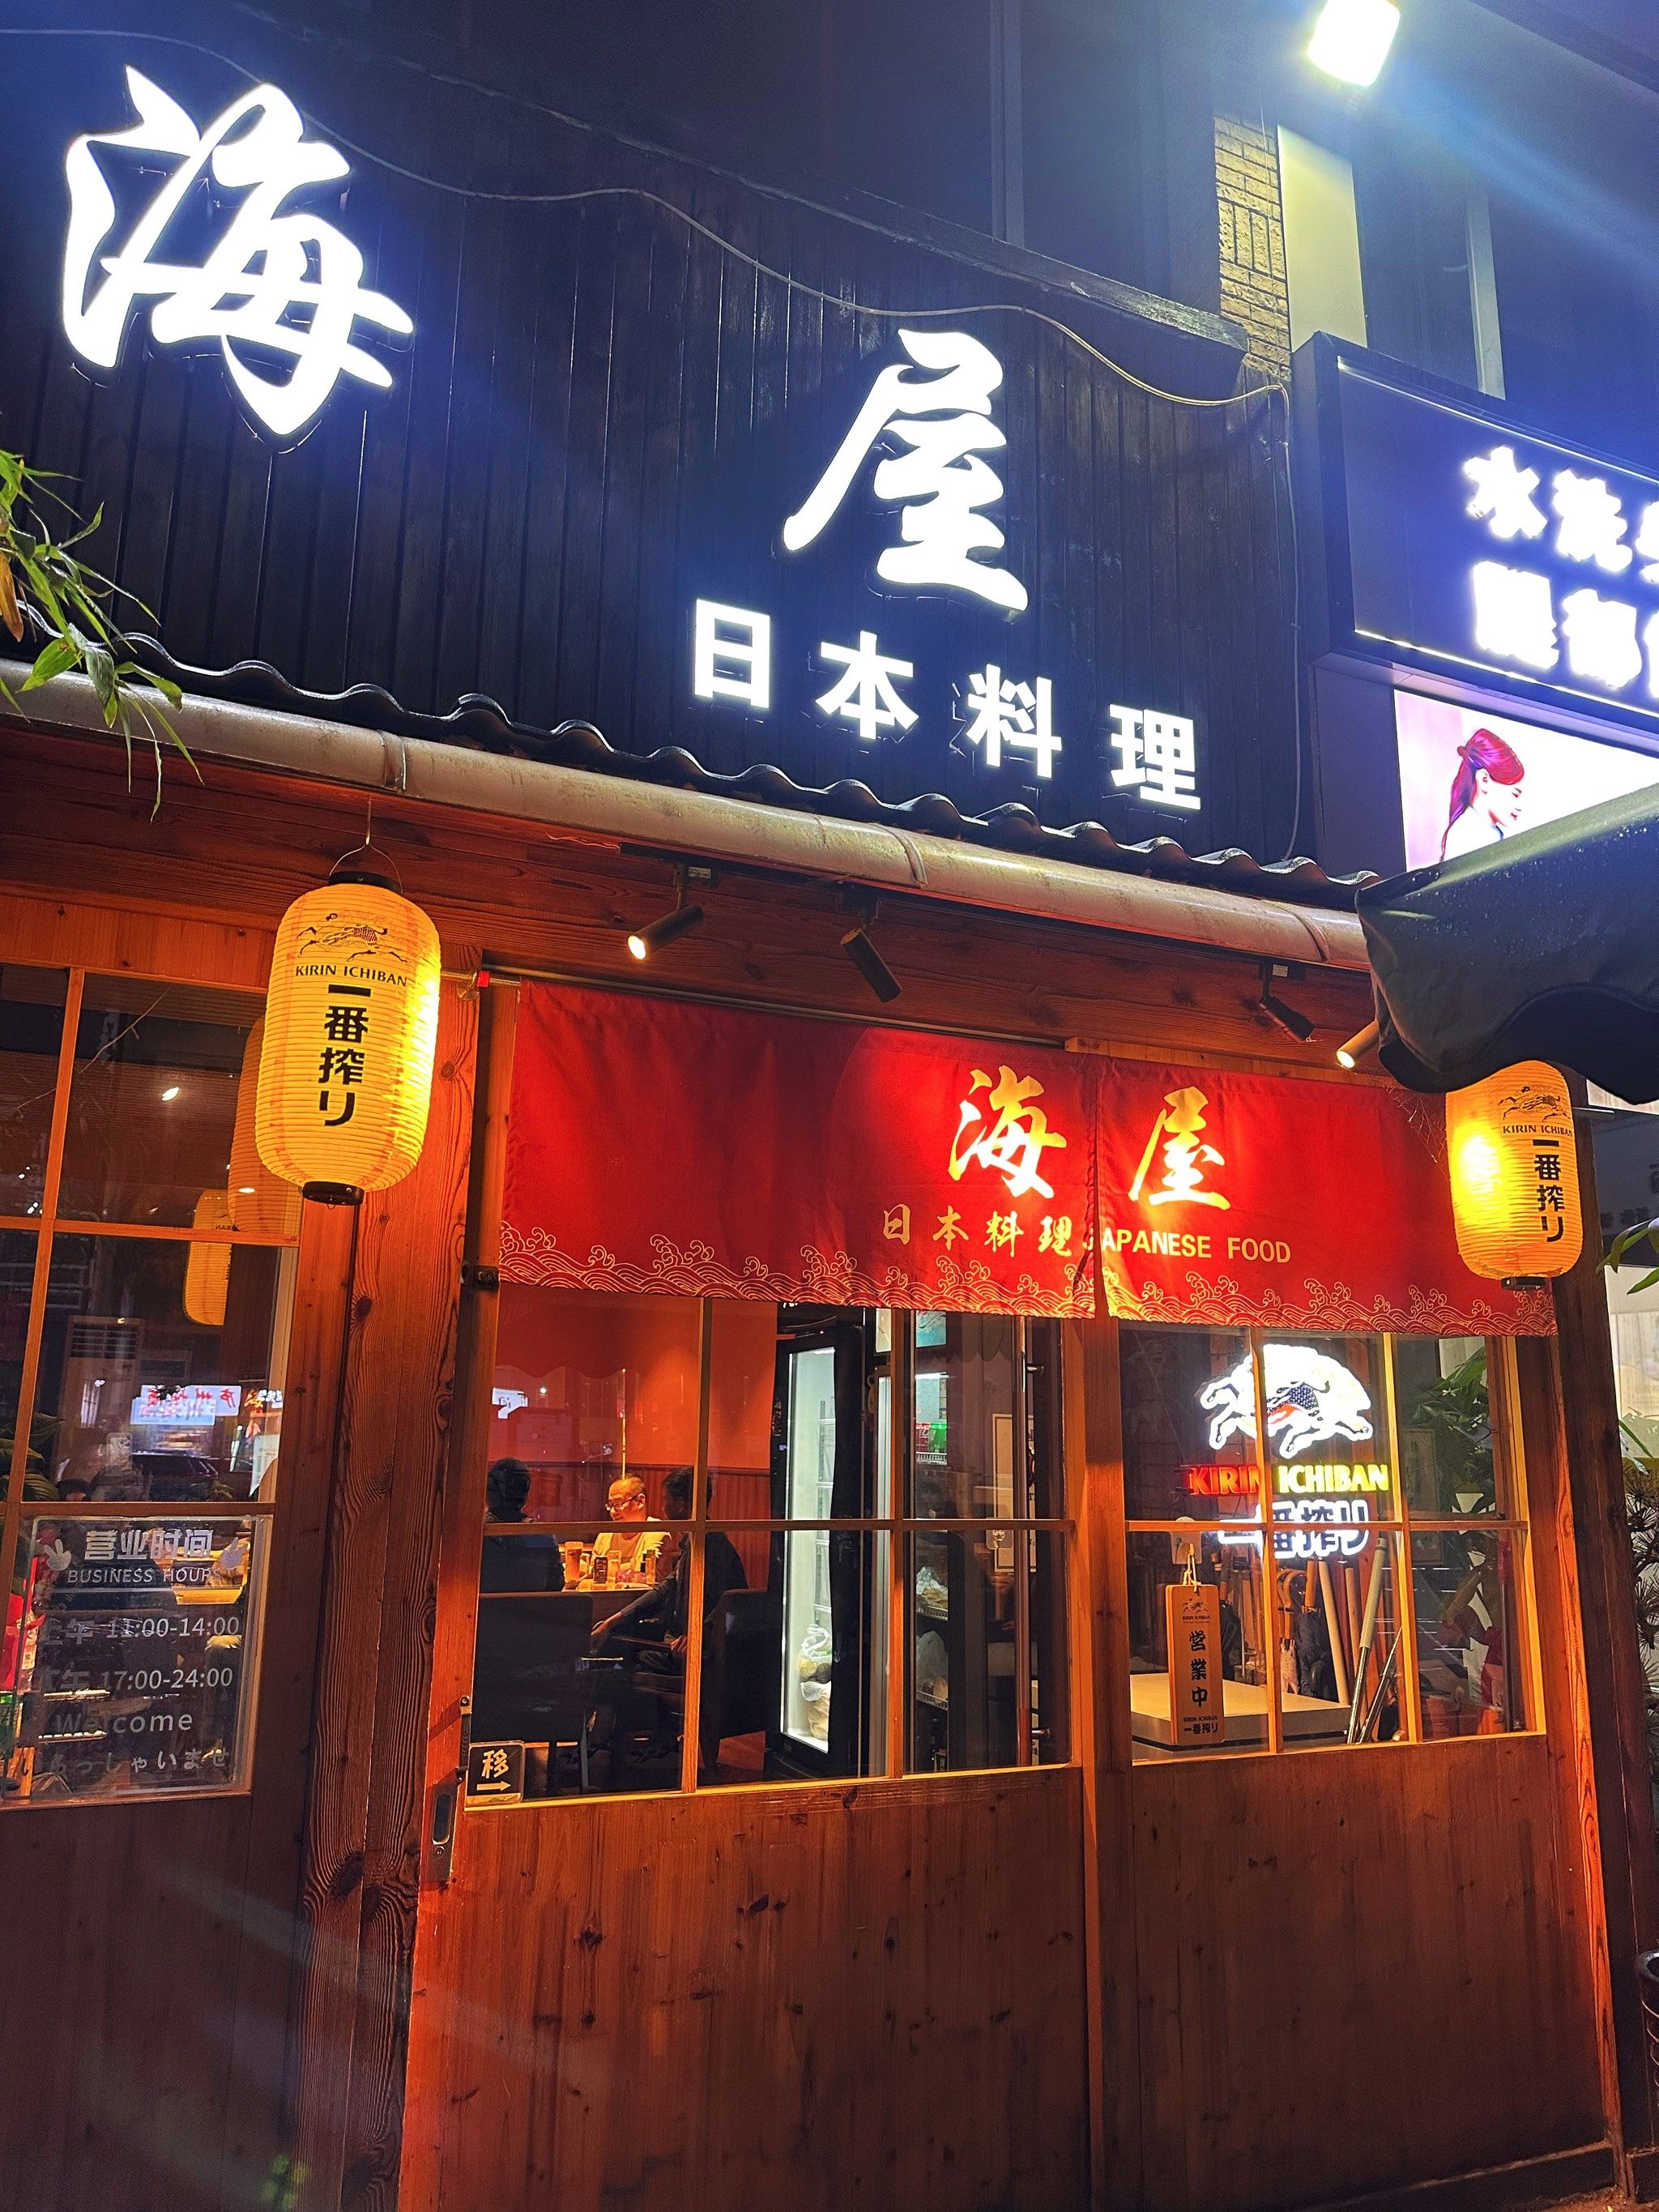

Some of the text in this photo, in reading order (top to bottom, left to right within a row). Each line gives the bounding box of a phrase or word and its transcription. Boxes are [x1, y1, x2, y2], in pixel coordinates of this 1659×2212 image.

[693, 599, 1202, 811] 日本料理
[296, 964, 407, 988] KIRIN ICHIBAN
[318, 984, 372, 1126] 一番搾り
[948, 1065, 1230, 1211] 海屋
[1503, 1125, 1574, 1138] KIRIN ICHIBAN
[1533, 1138, 1565, 1242] 一番搾り
[882, 1203, 1292, 1264] 日本料理 JAPANESE FOOD
[1277, 1463, 1389, 1494] ICHIBAN
[84, 1529, 215, 1561] 营业时间
[67, 1565, 221, 1584] BUSINESS HOURS
[107, 1616, 240, 1638] 11:00-14:00
[100, 1667, 234, 1690] 17:00-24:00
[1189, 1630, 1208, 1707] 営業中
[481, 1749, 510, 1779] 移
